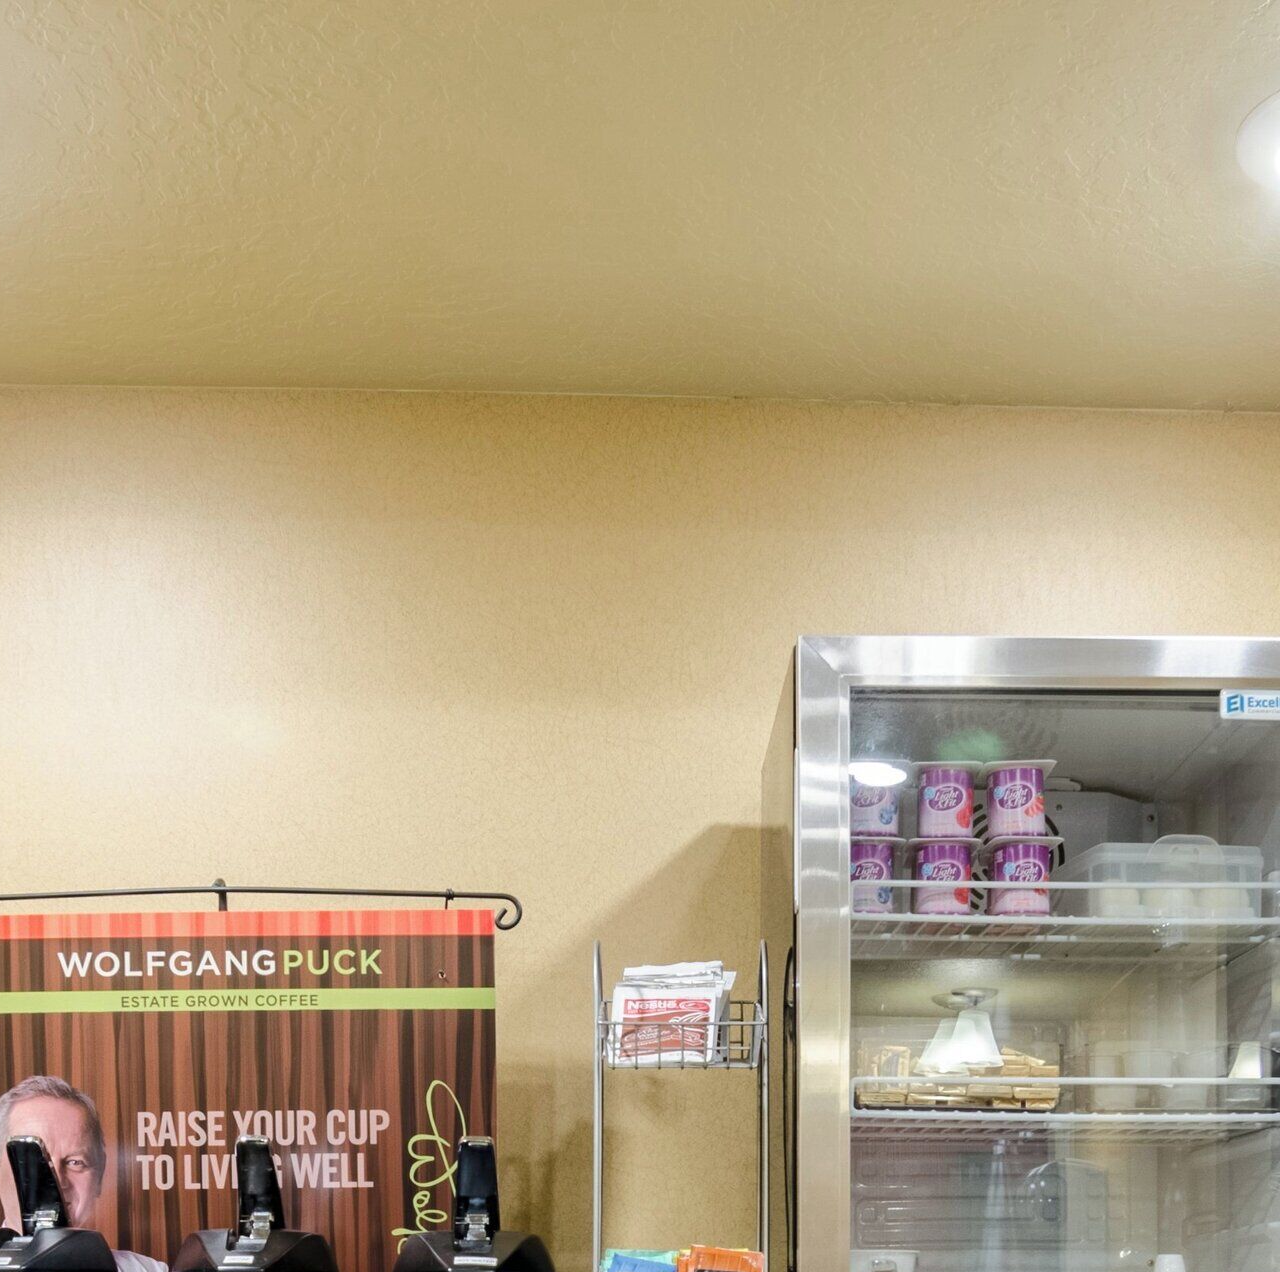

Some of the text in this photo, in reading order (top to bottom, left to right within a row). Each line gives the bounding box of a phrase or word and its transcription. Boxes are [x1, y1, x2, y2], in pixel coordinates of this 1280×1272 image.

[121, 994, 319, 1008] ESTATE GROWN COFFEE
[137, 1109, 390, 1147] RAISE YOUR CUP
[136, 1152, 374, 1190] TO LIVI WELL
